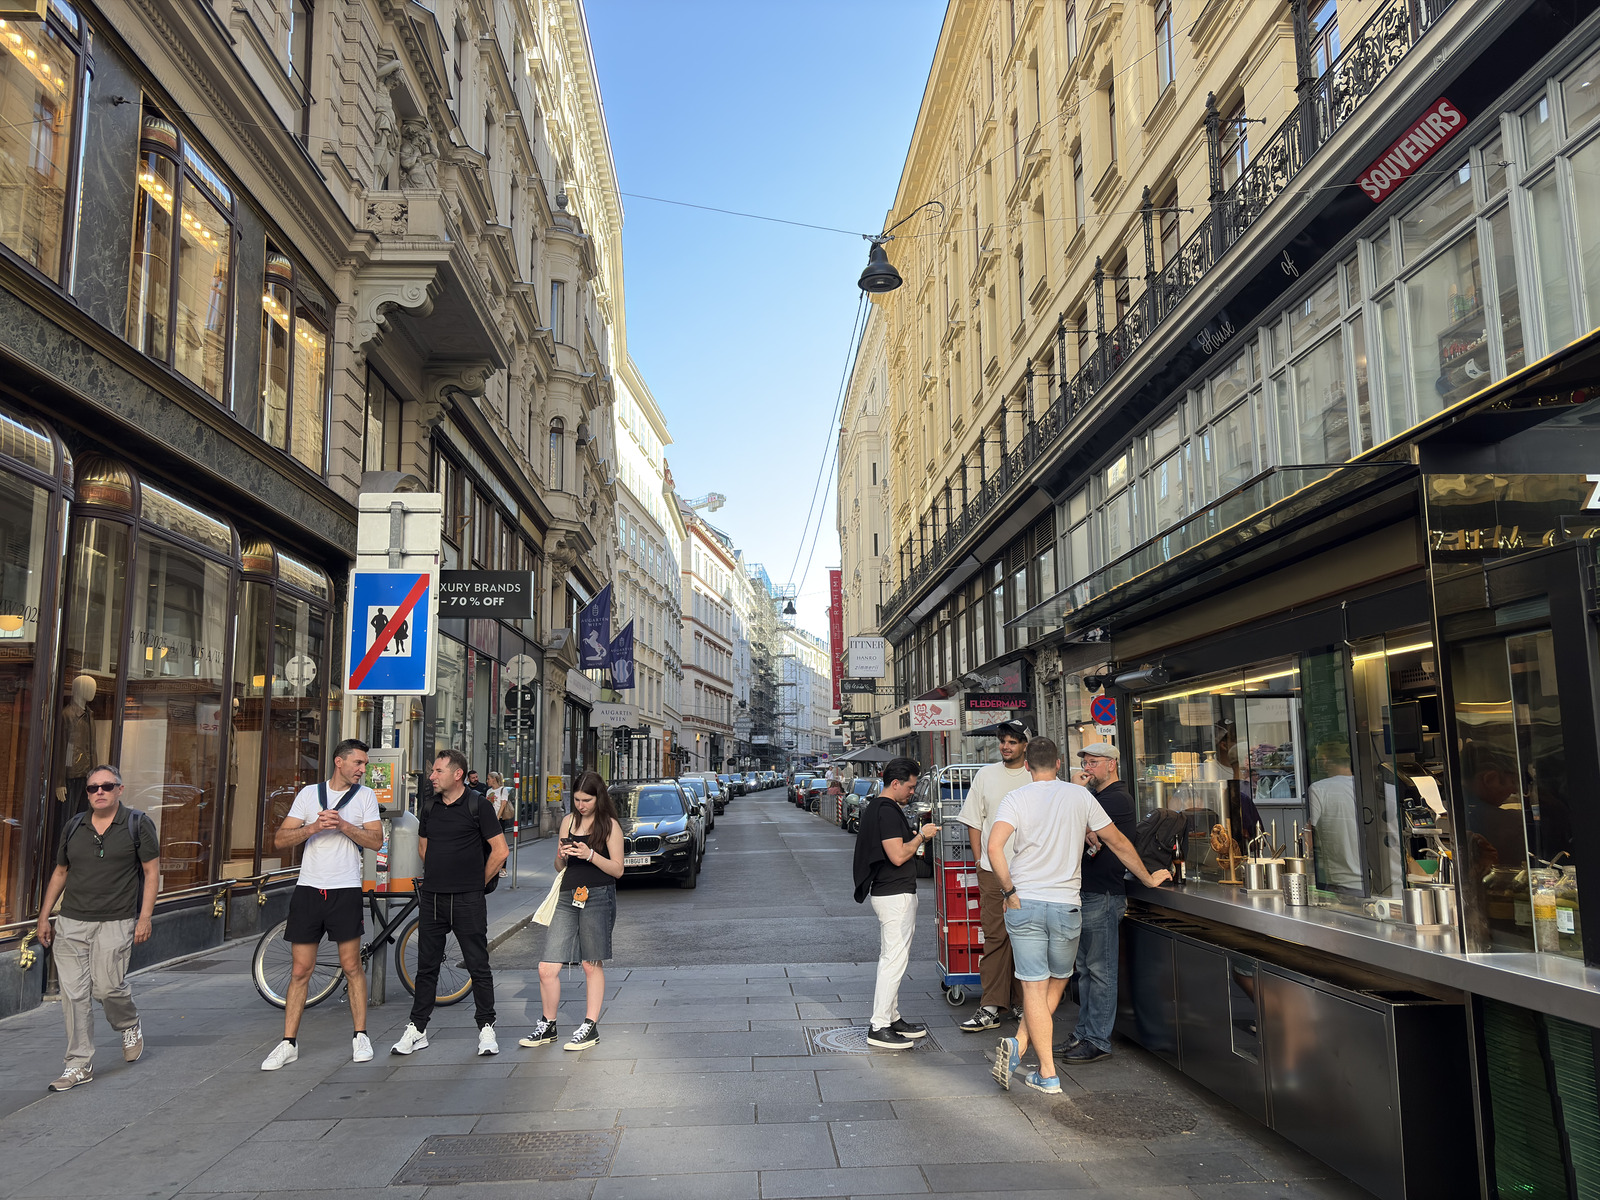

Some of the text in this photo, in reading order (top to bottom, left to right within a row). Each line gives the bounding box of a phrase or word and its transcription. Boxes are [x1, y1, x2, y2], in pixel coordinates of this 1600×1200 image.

[1197, 102, 1461, 355] House of SOUVENIRS
[440, 583, 521, 593] XURY BRANDS
[482, 597, 505, 606] OFF
[970, 700, 1027, 708] FLEDERMAUS
